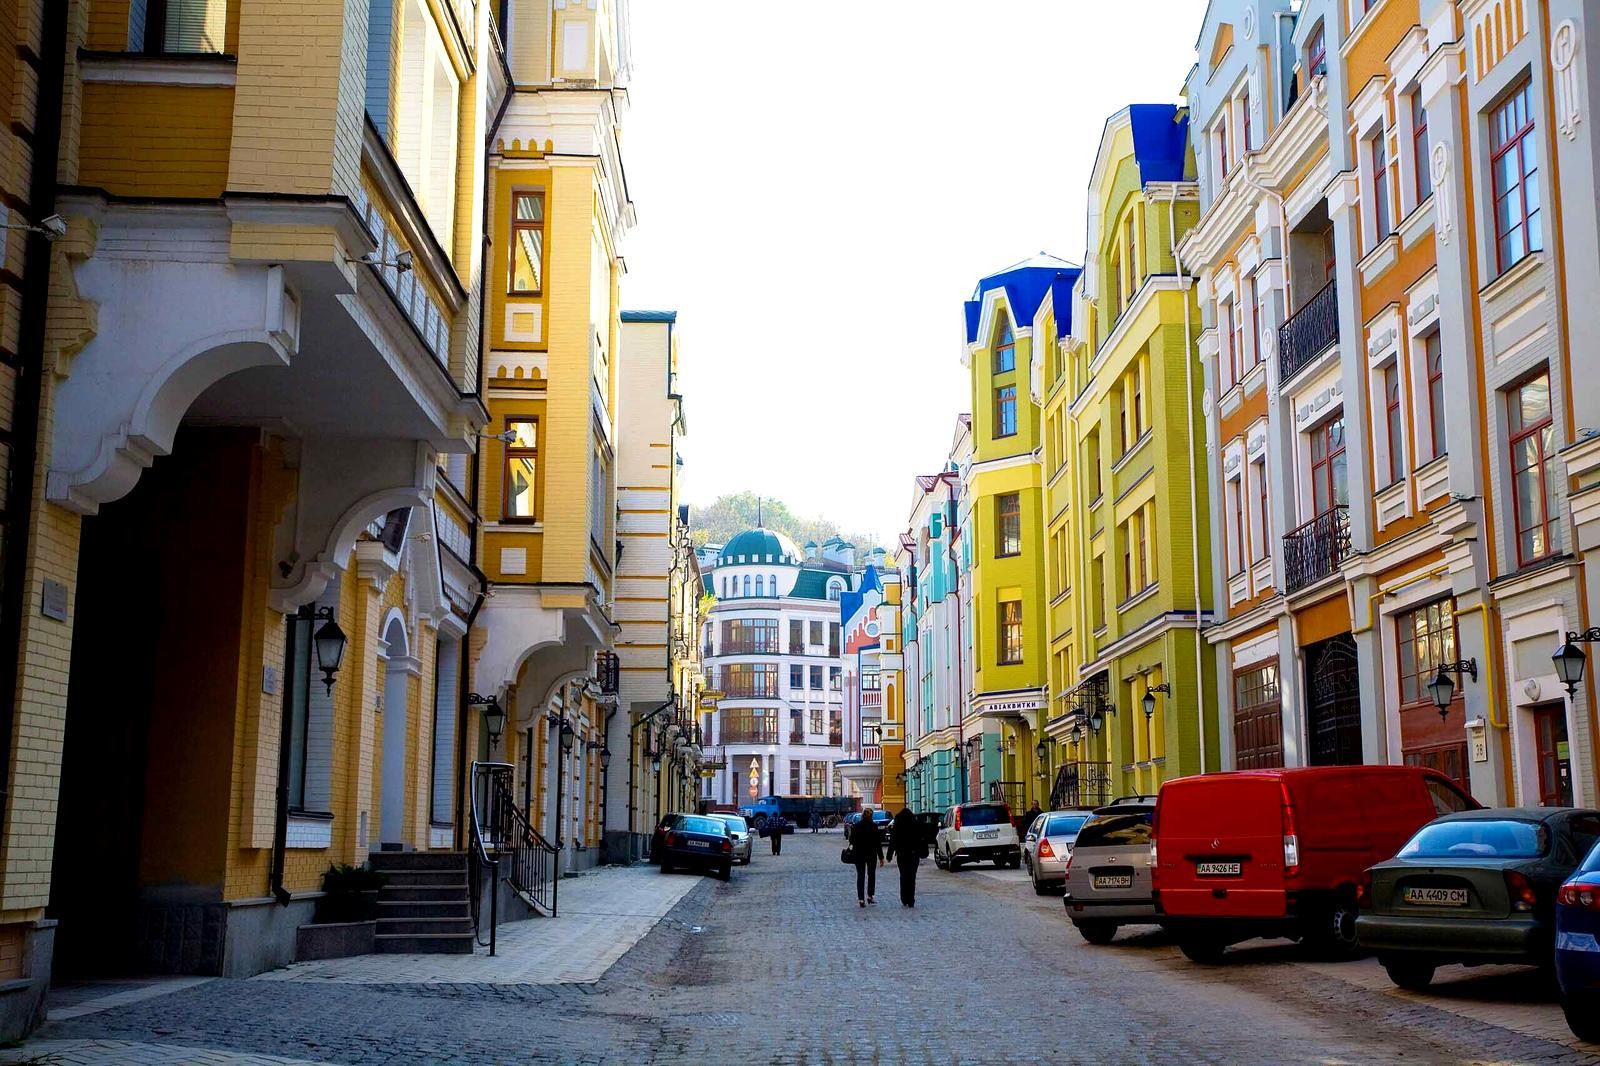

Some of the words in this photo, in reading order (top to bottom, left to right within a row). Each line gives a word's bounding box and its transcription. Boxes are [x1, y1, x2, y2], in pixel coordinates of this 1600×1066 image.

[989, 702, 1036, 710] АВІАКВИТКИ
[1201, 864, 1211, 872] AA
[1212, 864, 1227, 872] 9426
[1228, 864, 1238, 872] HE
[1410, 890, 1424, 899] AA
[1426, 890, 1448, 900] 4409
[1450, 891, 1465, 901] CM
